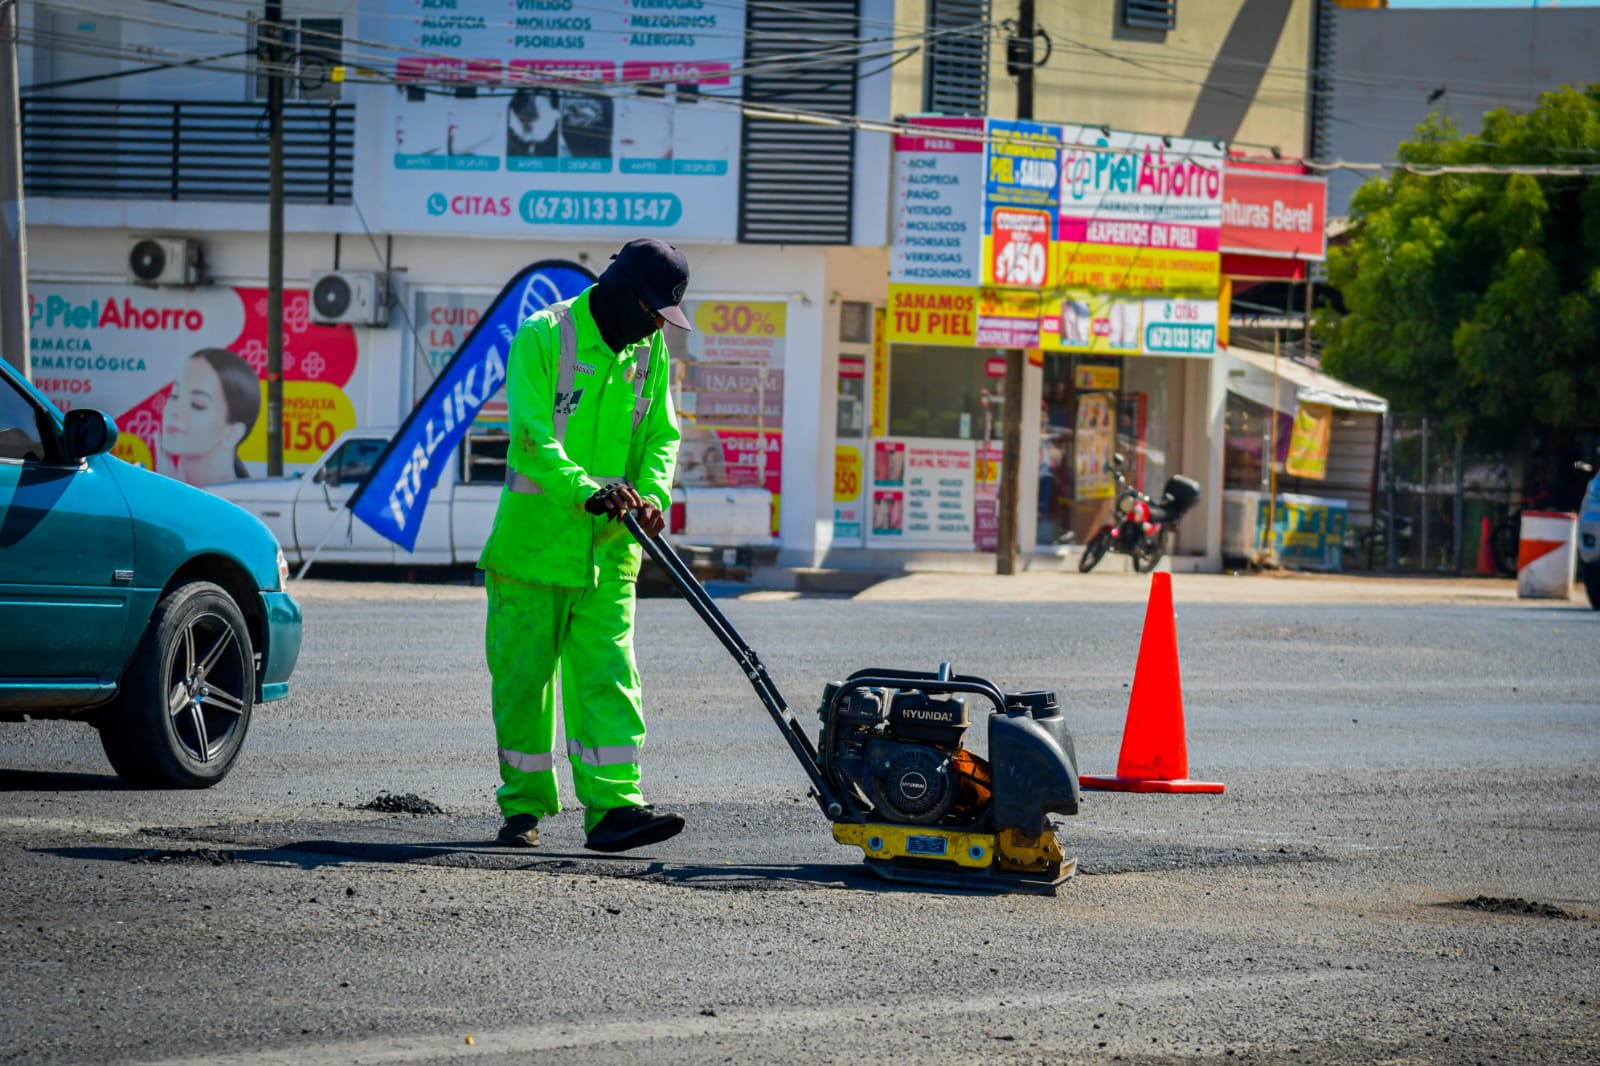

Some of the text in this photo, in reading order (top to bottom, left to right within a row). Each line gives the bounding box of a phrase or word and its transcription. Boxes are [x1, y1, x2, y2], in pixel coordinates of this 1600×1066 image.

[421, 16, 486, 29] ALOPECIA
[516, 17, 592, 30] MOLUSCOS
[630, 15, 717, 28] MEZQUINOS
[421, 32, 462, 47] PAÑO
[515, 35, 585, 49] PSORIASIS
[629, 34, 695, 47] ALERGIAS
[1095, 138, 1219, 199] PielAhorro
[908, 175, 959, 184] ALOPECIA
[451, 195, 512, 216] CITAS
[623, 198, 672, 221] 1547
[1222, 198, 1313, 233] nturas Berel
[906, 222, 966, 232] MOLUSCOS
[905, 237, 960, 247] PSORIASIS
[1150, 225, 1168, 247] EN
[1170, 228, 1197, 249] PIEL!
[905, 253, 962, 263] VERRUGAS
[996, 241, 1045, 284] $150
[904, 268, 972, 278] MEZQUINOS
[895, 292, 974, 312] SANAMOS
[46, 295, 204, 331] PielAhorro
[430, 307, 480, 327] CUID
[711, 303, 775, 334] 30%
[1175, 304, 1198, 320] CITAS
[894, 310, 920, 334] TU
[927, 312, 972, 336] PIEL
[31, 338, 92, 351] RMACIA
[430, 329, 456, 348] LA
[31, 354, 147, 371] RMATOLÓGICA
[33, 378, 92, 394] PERTOS
[283, 397, 336, 410] NSULTA
[389, 344, 506, 532] ITALIKA
[902, 709, 953, 721] HYUNDAI
